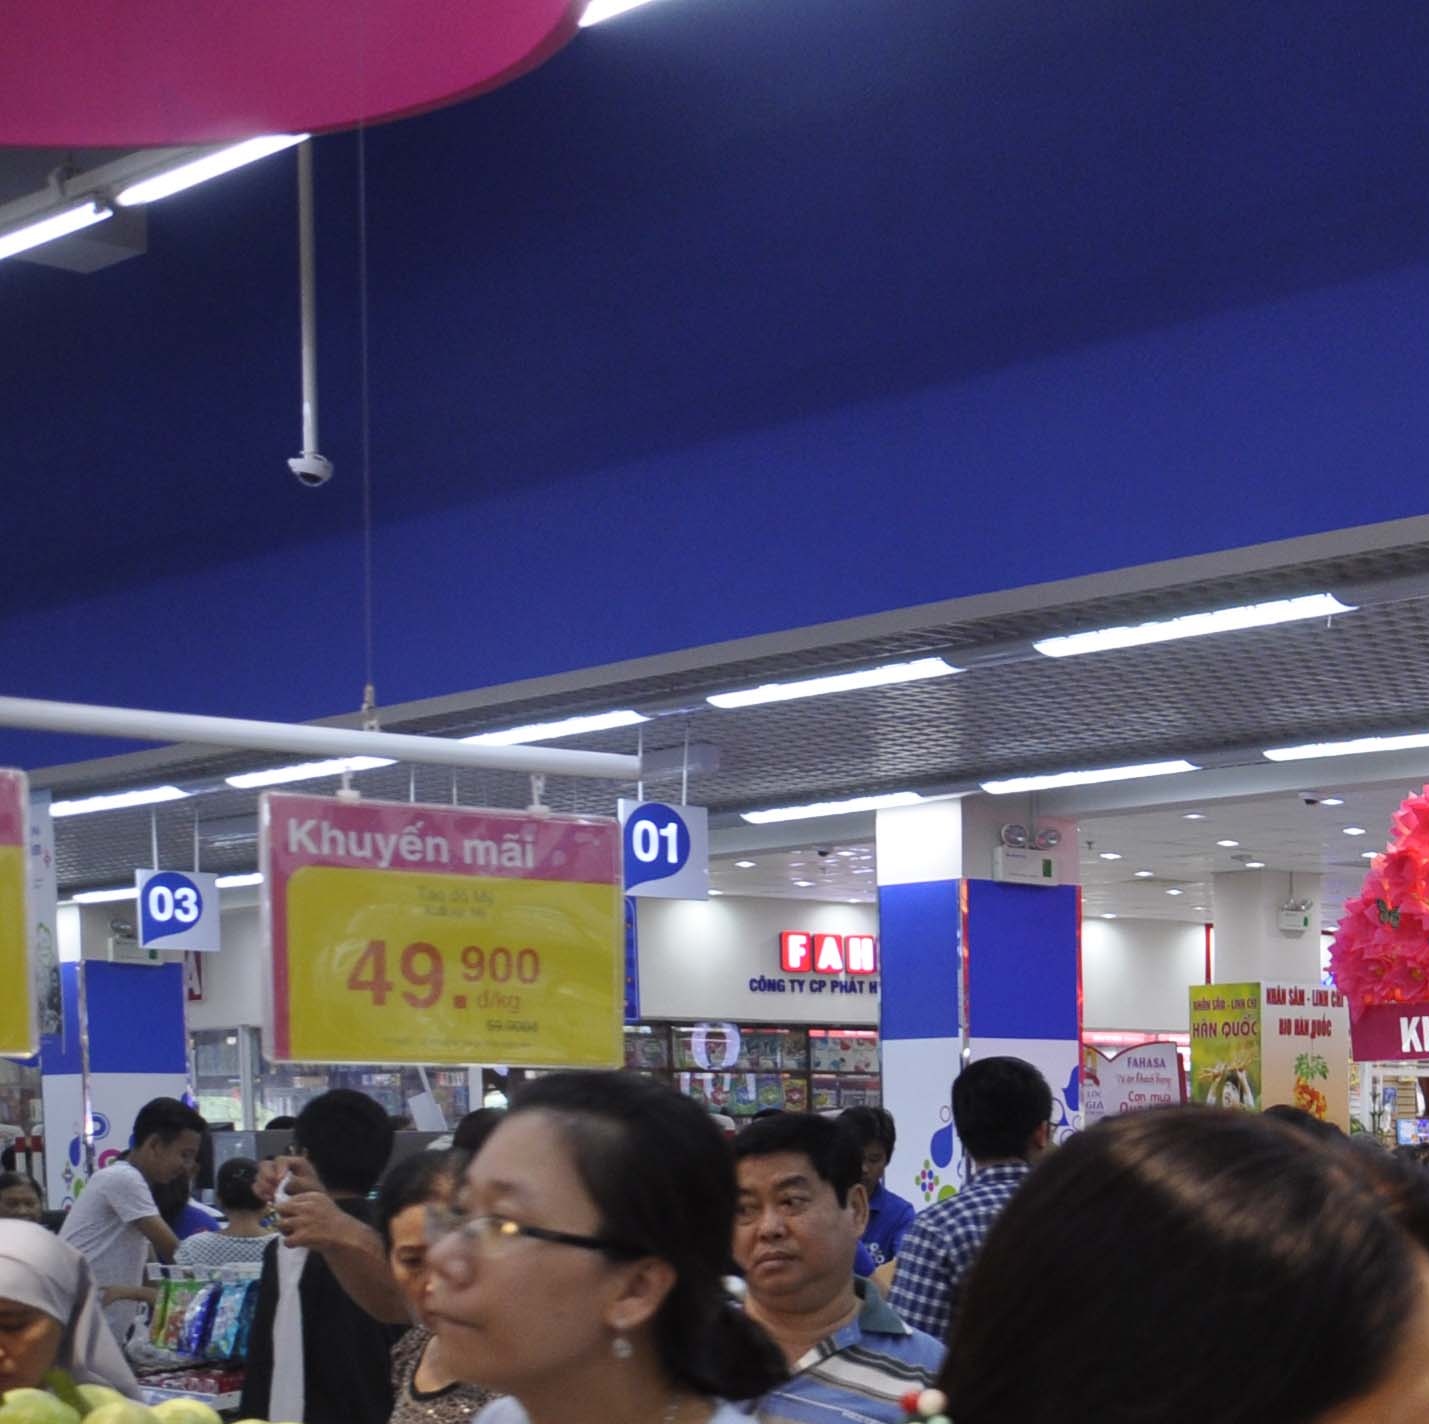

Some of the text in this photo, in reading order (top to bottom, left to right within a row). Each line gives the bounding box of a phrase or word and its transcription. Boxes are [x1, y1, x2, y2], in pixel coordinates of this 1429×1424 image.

[286, 817, 535, 869] Khuyến mãi
[632, 819, 679, 864] 01
[149, 886, 199, 923] 03
[749, 974, 785, 993] CÔNG
[789, 979, 806, 993] TY
[809, 980, 826, 993] CP
[830, 977, 865, 994] PHÁT
[1127, 1056, 1166, 1068] FAHASA
